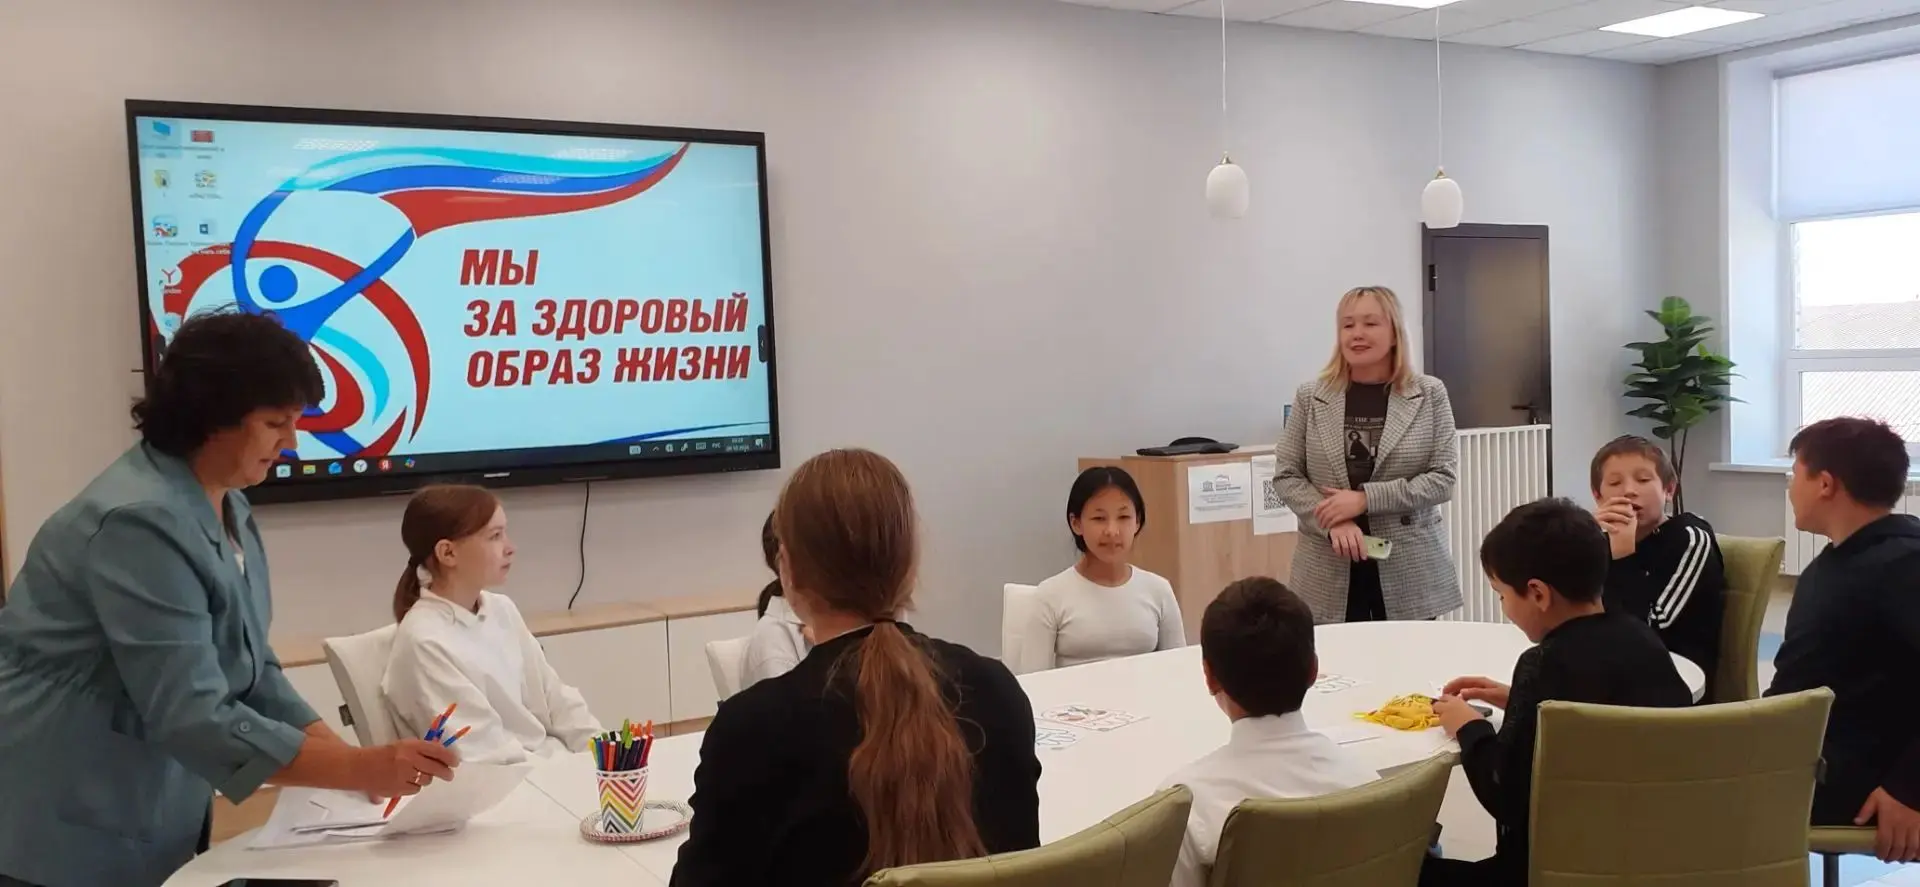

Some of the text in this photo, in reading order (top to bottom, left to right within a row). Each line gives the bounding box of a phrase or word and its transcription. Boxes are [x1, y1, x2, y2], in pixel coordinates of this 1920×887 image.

[460, 249, 538, 286] МЫ
[464, 292, 748, 341] ЗА ЗДОРОВЫЙ
[467, 346, 751, 387] ОБРАЗ ЖИЗНИ
